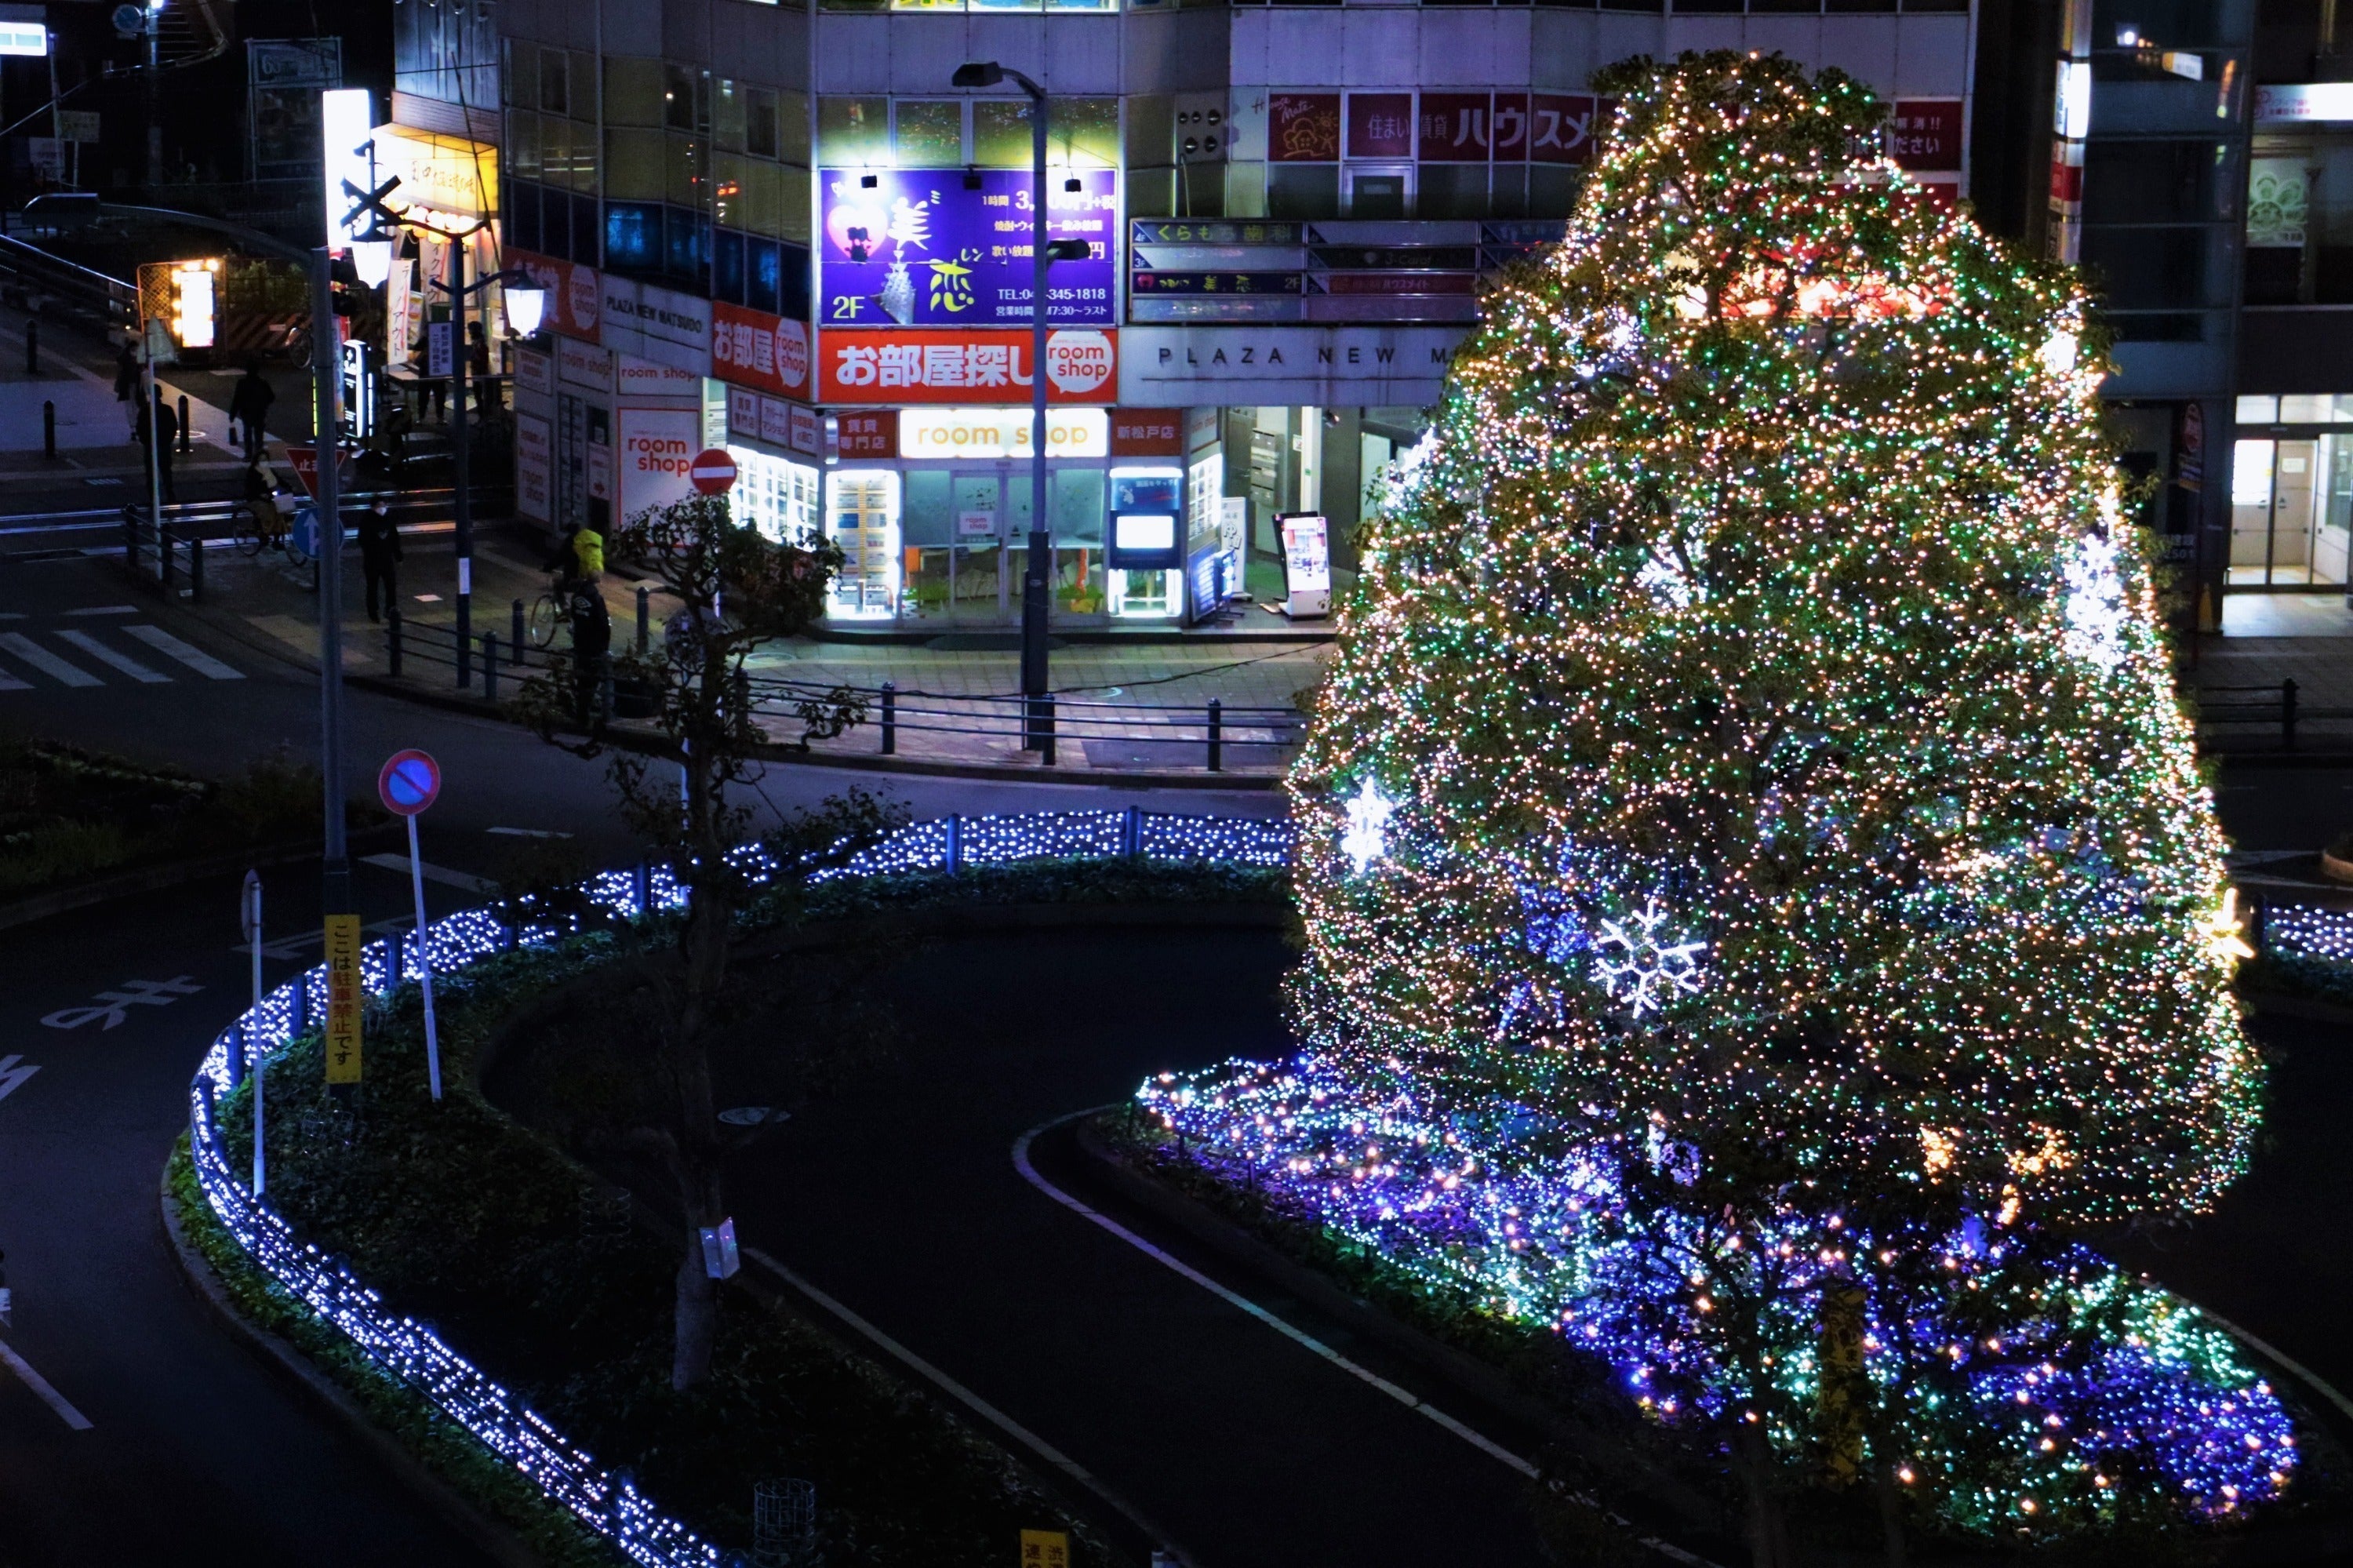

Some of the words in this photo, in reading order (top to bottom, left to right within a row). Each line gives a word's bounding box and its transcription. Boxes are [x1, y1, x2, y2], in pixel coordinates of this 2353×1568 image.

[1134, 258, 1146, 267] 3F
[606, 296, 635, 315] PLAZA
[832, 296, 865, 319] 2F
[714, 319, 774, 375] お部屋
[776, 336, 804, 355] room
[1049, 347, 1104, 359] room
[1158, 347, 1282, 364] PLAZA
[1318, 347, 1394, 364] NEW
[621, 368, 658, 379] room
[664, 367, 696, 380] shop
[781, 353, 806, 377] shop
[836, 344, 1033, 387] お部屋探し
[1057, 358, 1107, 381] shop
[918, 426, 1000, 446] room
[1016, 424, 1089, 446] sop
[1117, 426, 1174, 439] 新松戸店
[628, 438, 686, 453] room
[638, 450, 690, 477] shop
[333, 925, 352, 1065] ここは駐車禁止です
